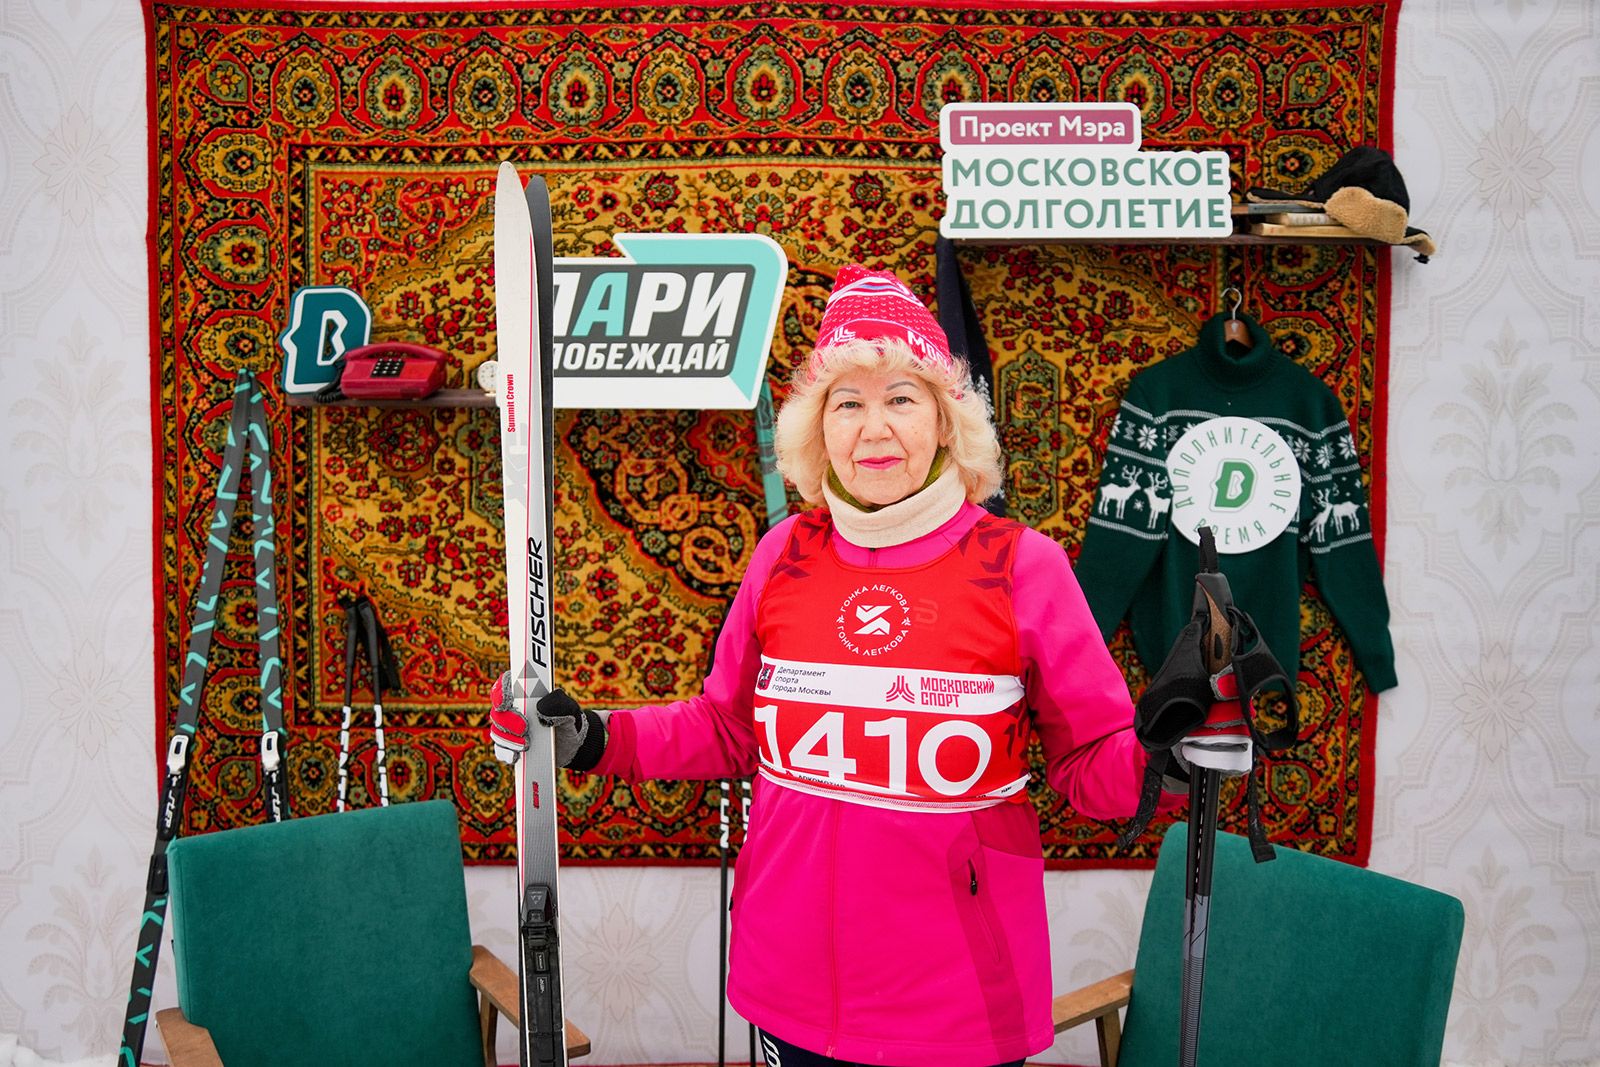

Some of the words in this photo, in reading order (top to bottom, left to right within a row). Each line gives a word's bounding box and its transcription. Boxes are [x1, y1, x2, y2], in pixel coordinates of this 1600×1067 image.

[959, 115, 1052, 142] Проект
[1059, 115, 1126, 142] Мэра
[951, 157, 1225, 187] МОСКОВСКОЕ
[949, 198, 1227, 229] ДОЛГОЛЕТИЕ
[506, 374, 515, 400] Crown
[507, 401, 516, 433] Summit
[528, 536, 547, 669] FISCHER
[840, 585, 869, 613] ГОНКА
[871, 584, 911, 614] ЛЕГКОВА
[837, 625, 860, 655] ГОНКА
[862, 629, 909, 657] ЛЕГКОВА
[775, 676, 799, 684] спорта
[776, 666, 826, 677] Департамент
[920, 676, 995, 695] МОСКОВСКИЙ
[772, 685, 797, 693] города
[798, 687, 831, 696] Москвы
[921, 692, 960, 708] СПОРТ
[754, 704, 993, 797] 1410
